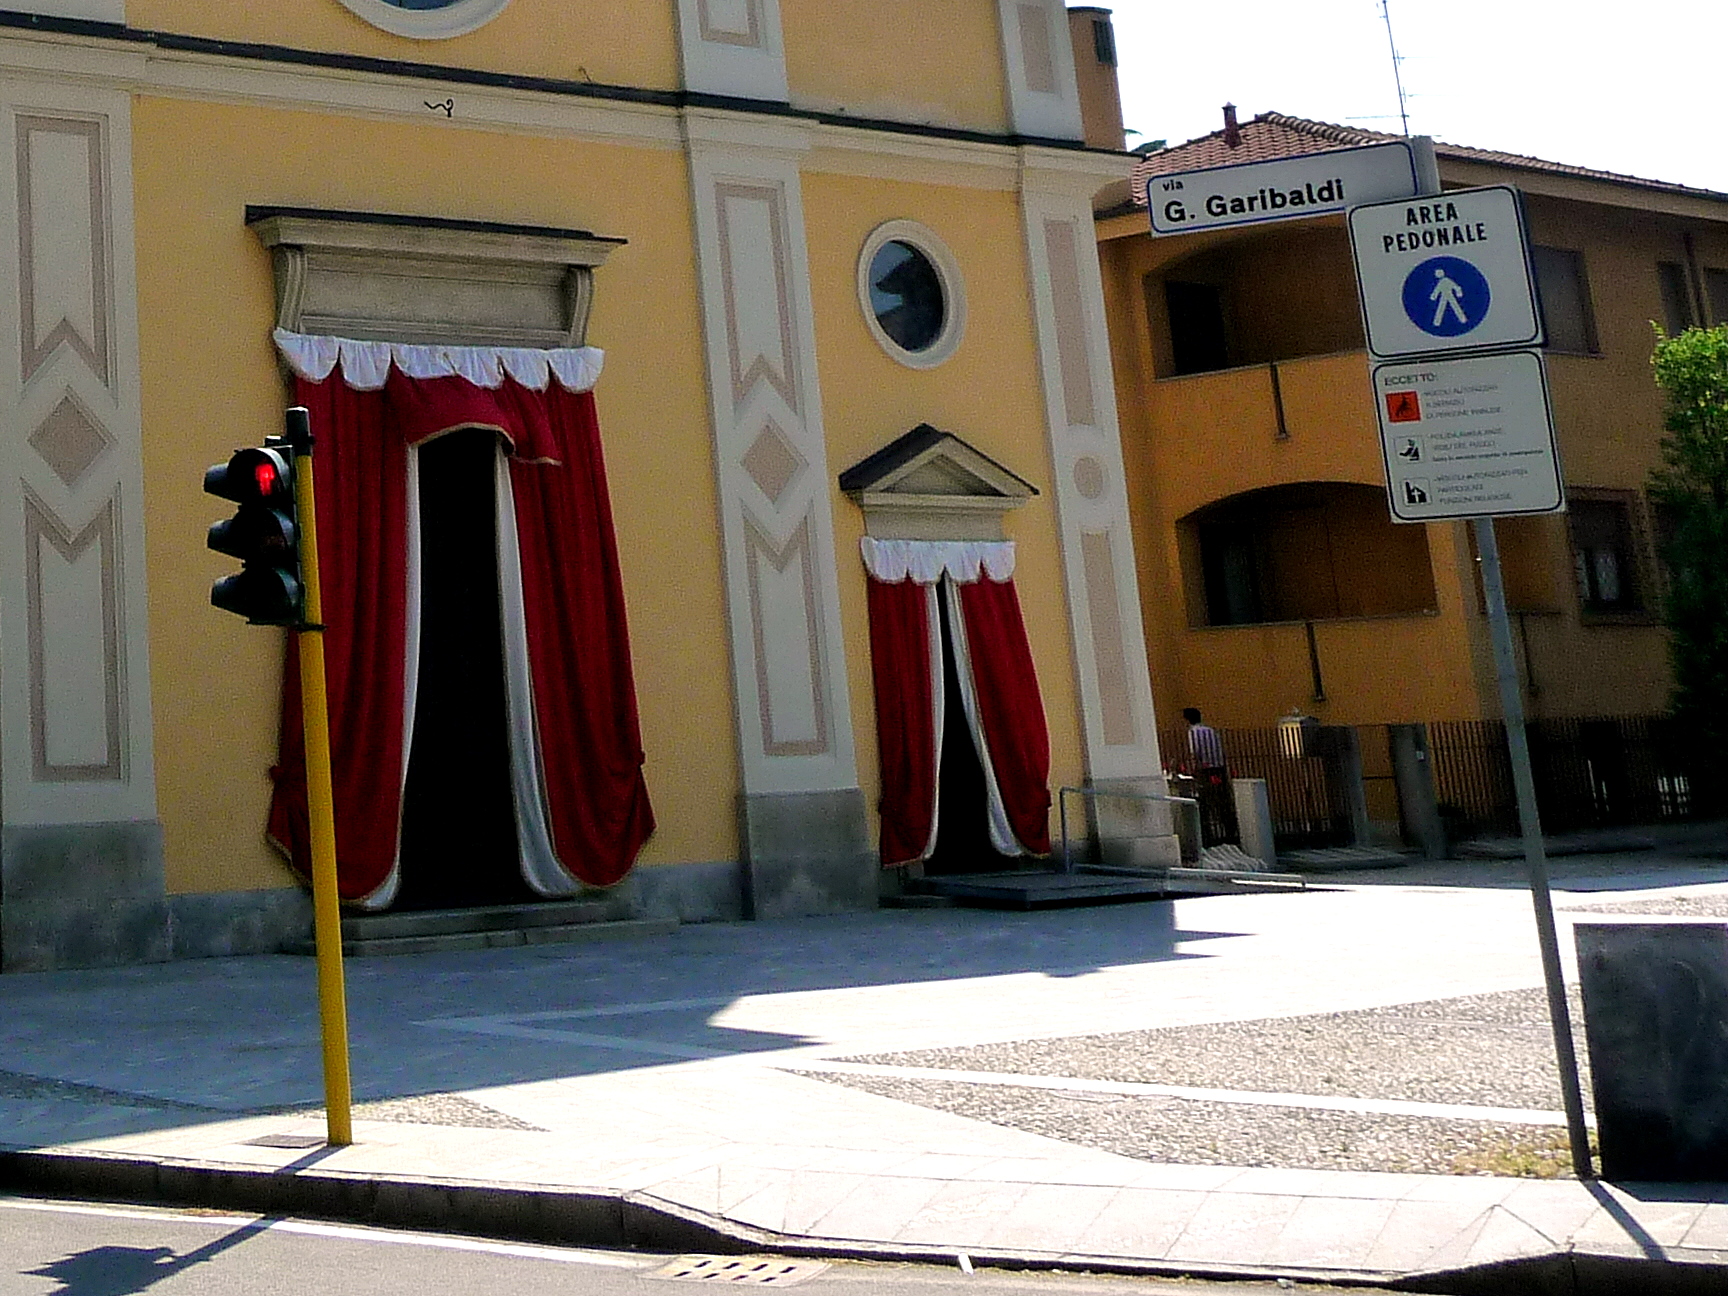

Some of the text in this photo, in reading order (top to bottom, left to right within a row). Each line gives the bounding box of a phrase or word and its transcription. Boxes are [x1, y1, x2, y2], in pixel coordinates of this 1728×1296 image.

[1162, 179, 1184, 192] via
[1164, 178, 1344, 222] G. Garibaldi
[1406, 203, 1459, 226] AREA
[1383, 223, 1488, 253] PEDONALE
